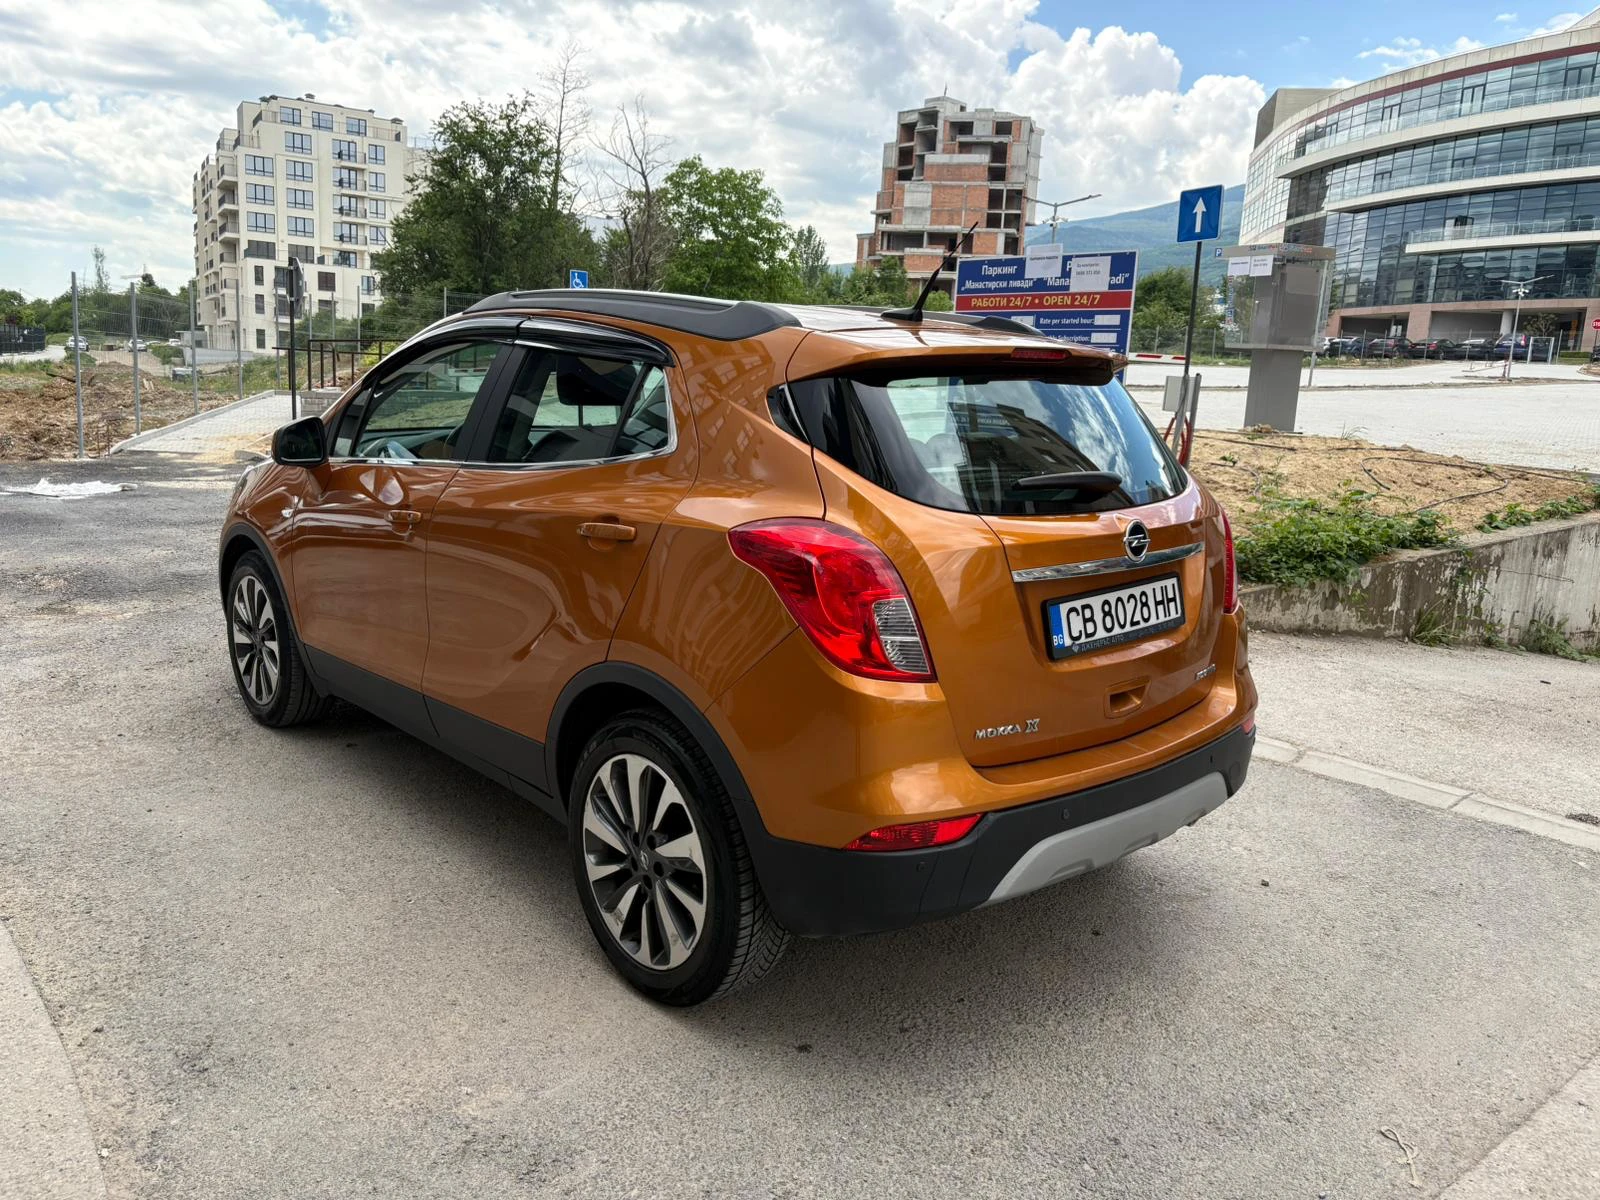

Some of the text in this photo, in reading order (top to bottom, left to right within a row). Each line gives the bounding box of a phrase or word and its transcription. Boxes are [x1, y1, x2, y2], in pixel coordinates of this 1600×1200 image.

[982, 265, 1018, 277] Паркинг
[971, 296, 1032, 307] РАБОТИ 24/7
[1043, 294, 1101, 306] OPEN 24/7
[1061, 317, 1080, 325] started
[1066, 603, 1098, 642] CB
[1101, 590, 1152, 634] 8028
[1152, 583, 1179, 620] HH
[1053, 634, 1064, 645] BG
[975, 718, 1040, 740] MOKKA X
